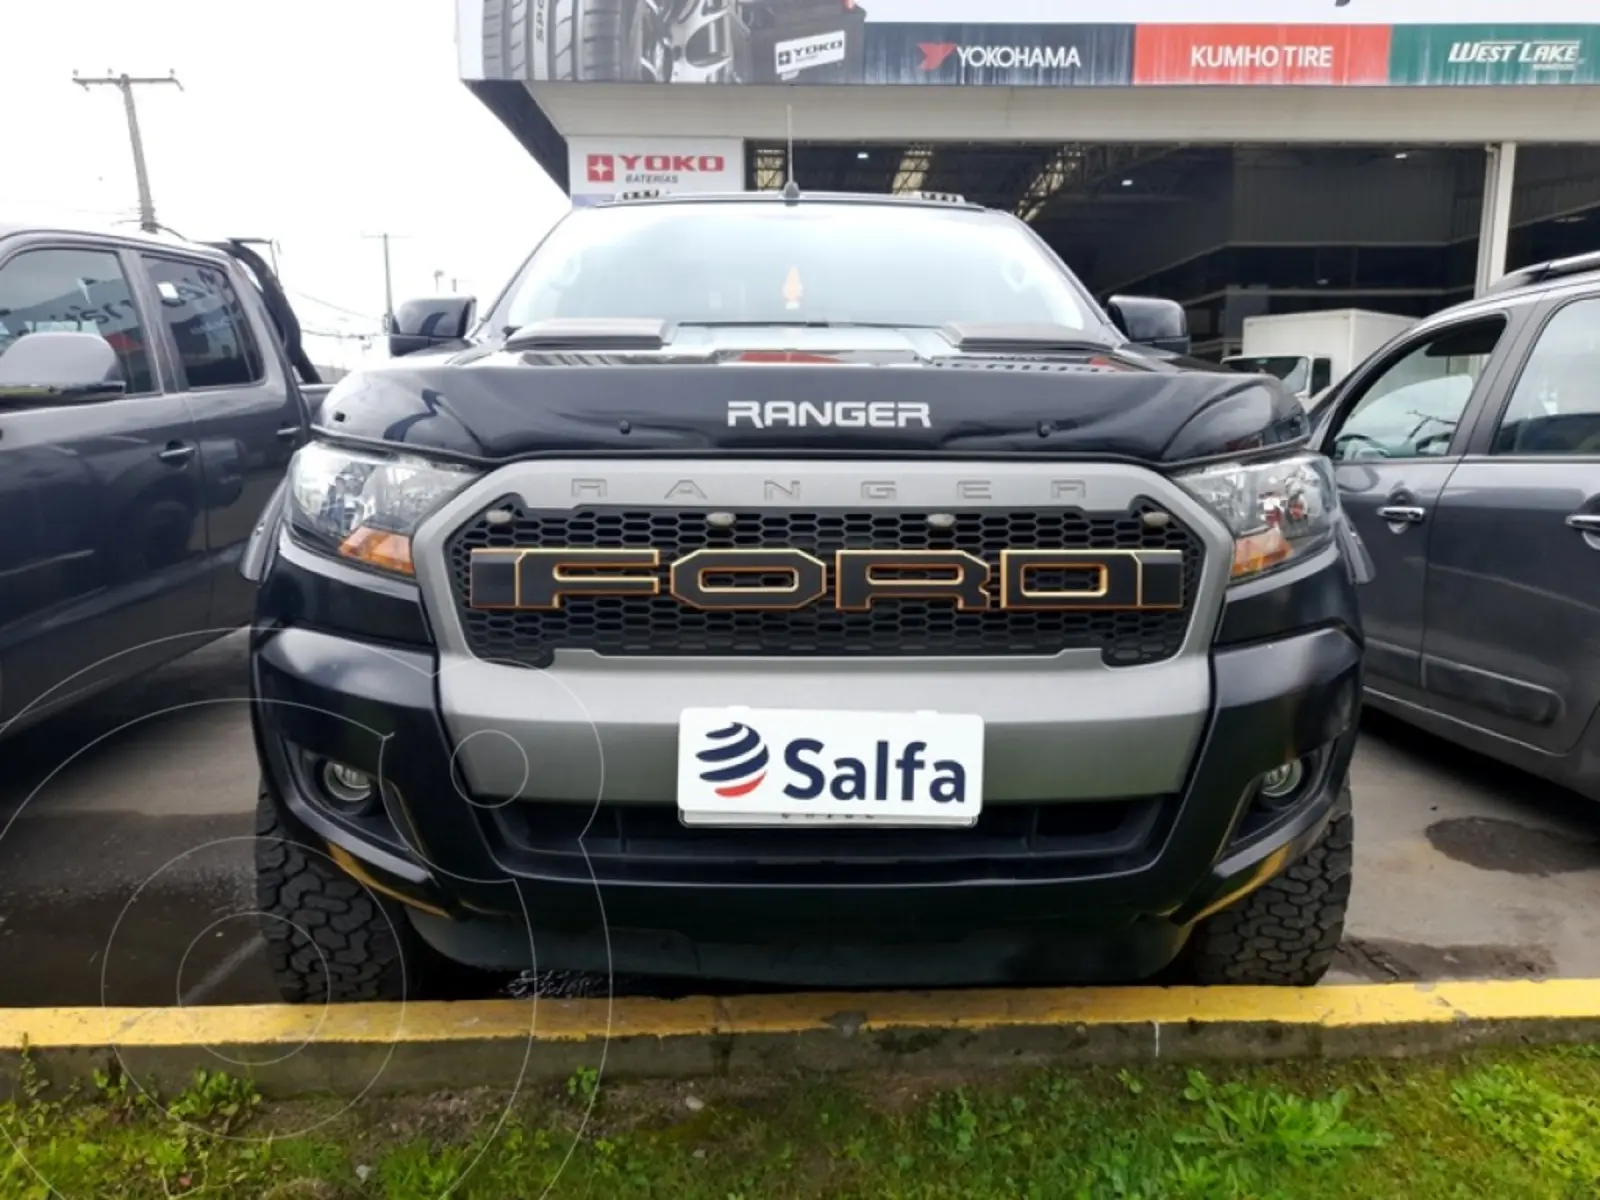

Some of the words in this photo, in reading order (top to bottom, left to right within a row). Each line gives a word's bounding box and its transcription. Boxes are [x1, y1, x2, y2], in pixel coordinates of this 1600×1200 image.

[956, 46, 1081, 68] YOKOHAMA
[1190, 45, 1279, 67] KUMHO
[1283, 45, 1334, 67] TIRE
[1448, 41, 1522, 63] WEST
[1518, 40, 1581, 63] LAKE
[619, 154, 724, 172] YOKO
[727, 400, 931, 428] RANGER
[571, 477, 1087, 500] RANGER
[469, 548, 1184, 610] FORD
[782, 737, 967, 803] Salfa
